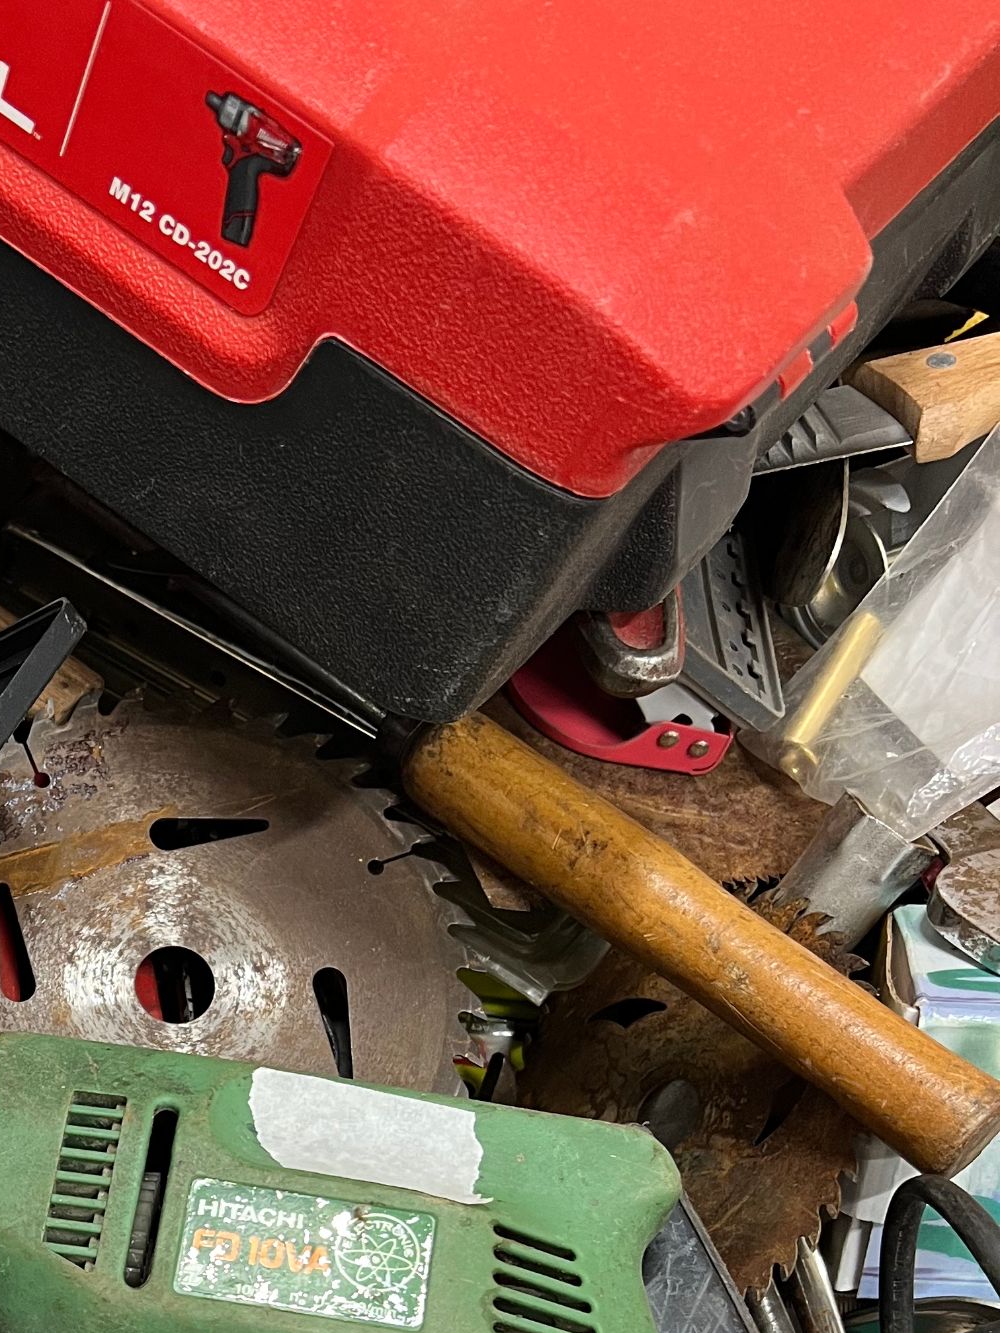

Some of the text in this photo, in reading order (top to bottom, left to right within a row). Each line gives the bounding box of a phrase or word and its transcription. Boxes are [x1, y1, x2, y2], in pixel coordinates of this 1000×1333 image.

[108, 176, 251, 291] M12 CD-202C
[197, 1199, 304, 1229] HITACHI
[248, 1235, 330, 1274] 10VA
